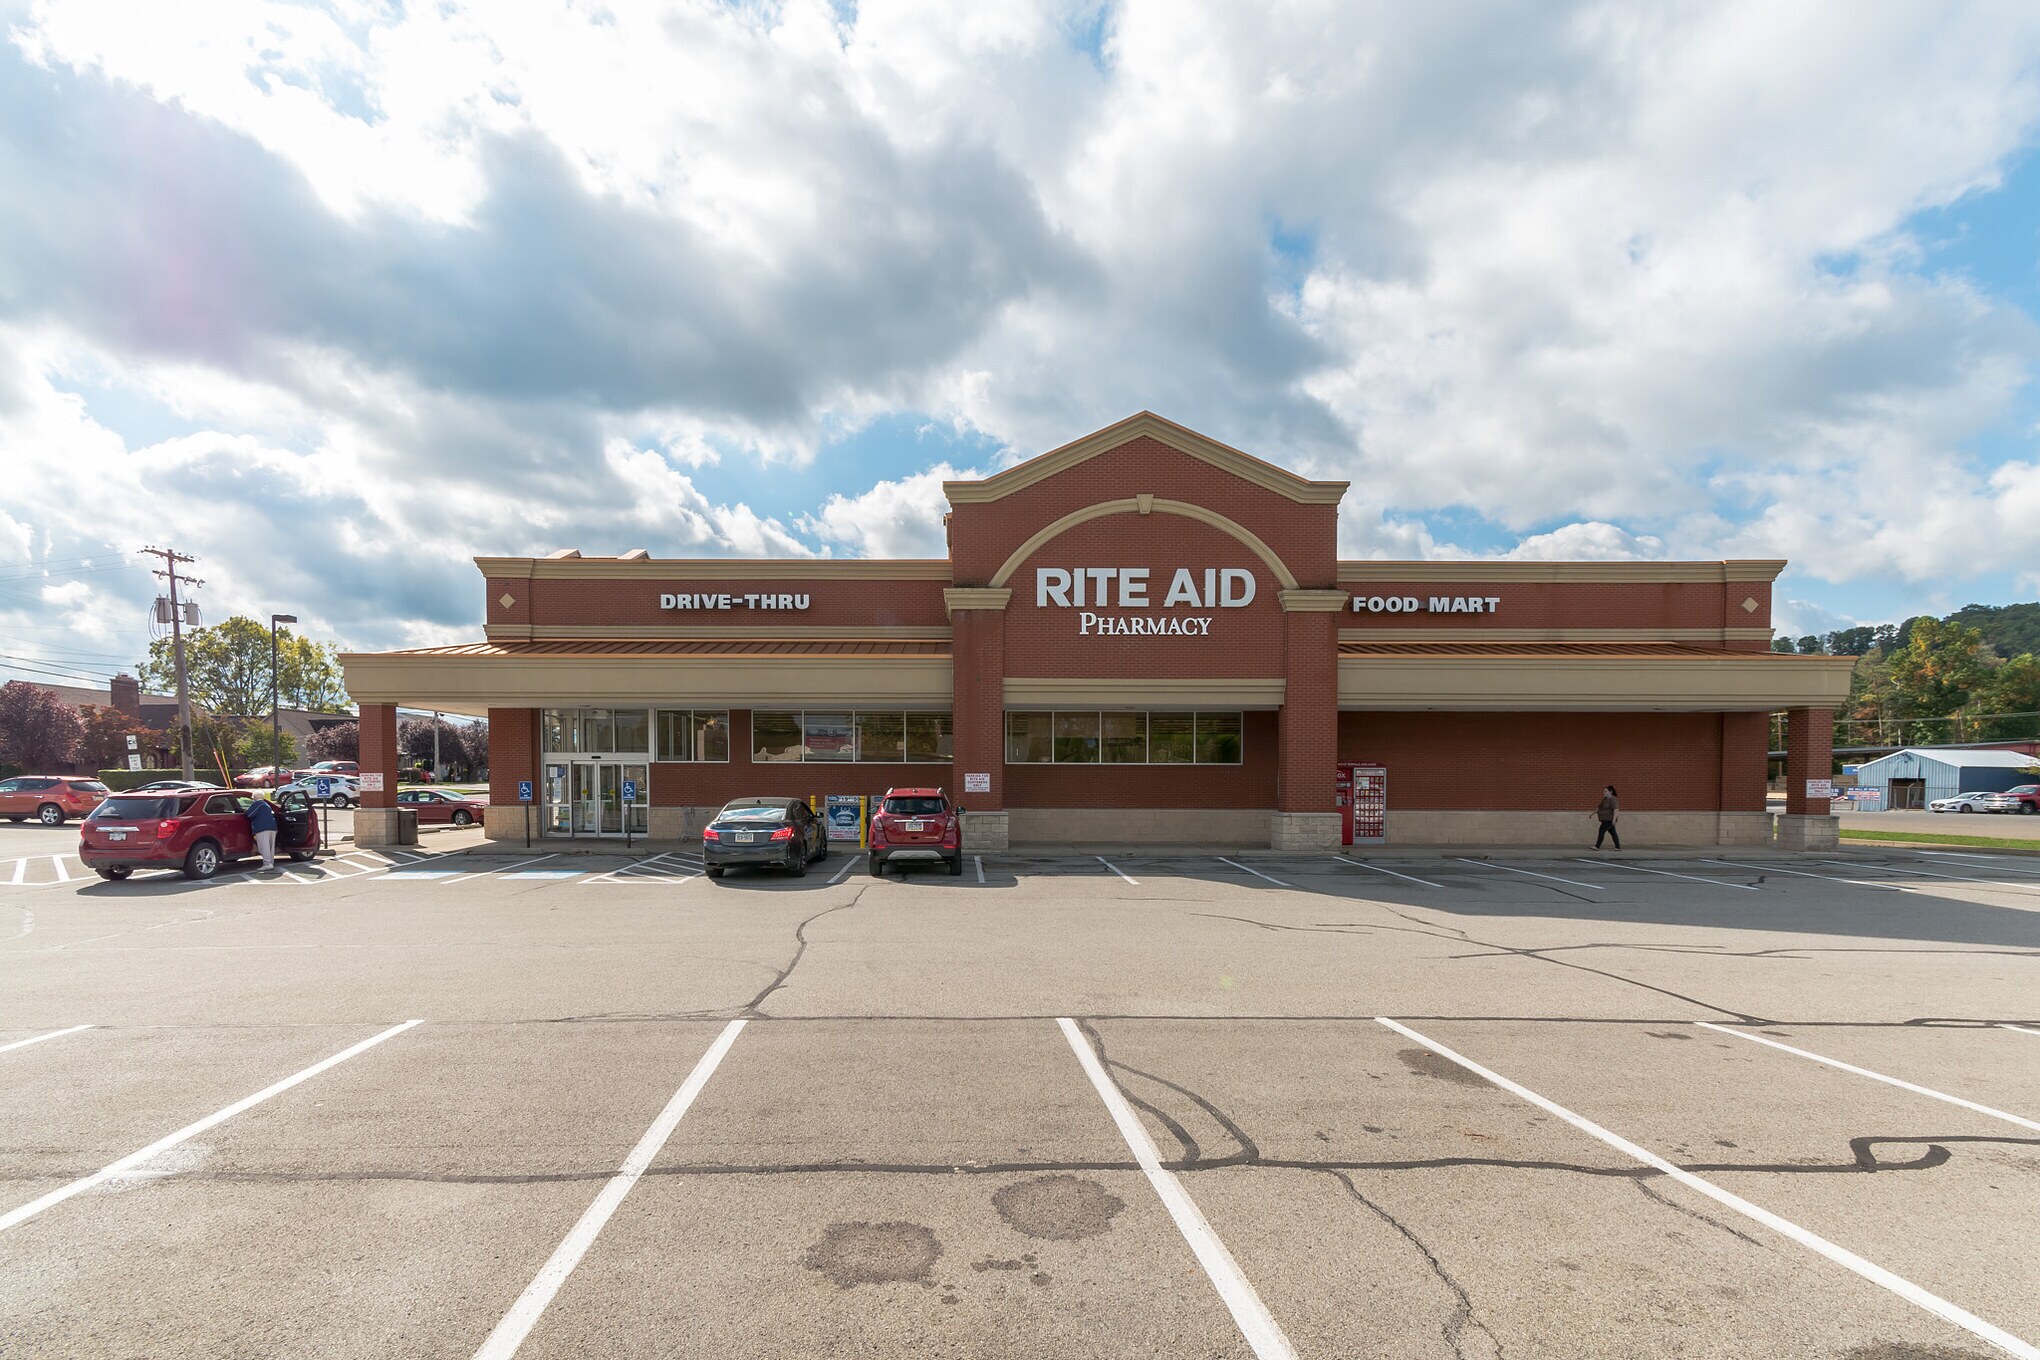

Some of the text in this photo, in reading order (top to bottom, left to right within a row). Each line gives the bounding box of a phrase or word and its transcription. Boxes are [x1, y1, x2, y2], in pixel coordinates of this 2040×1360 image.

[1036, 567, 1256, 608] RITE AID
[660, 593, 810, 610] DRIVE-THRU
[1352, 596, 1500, 613] FOOD MART
